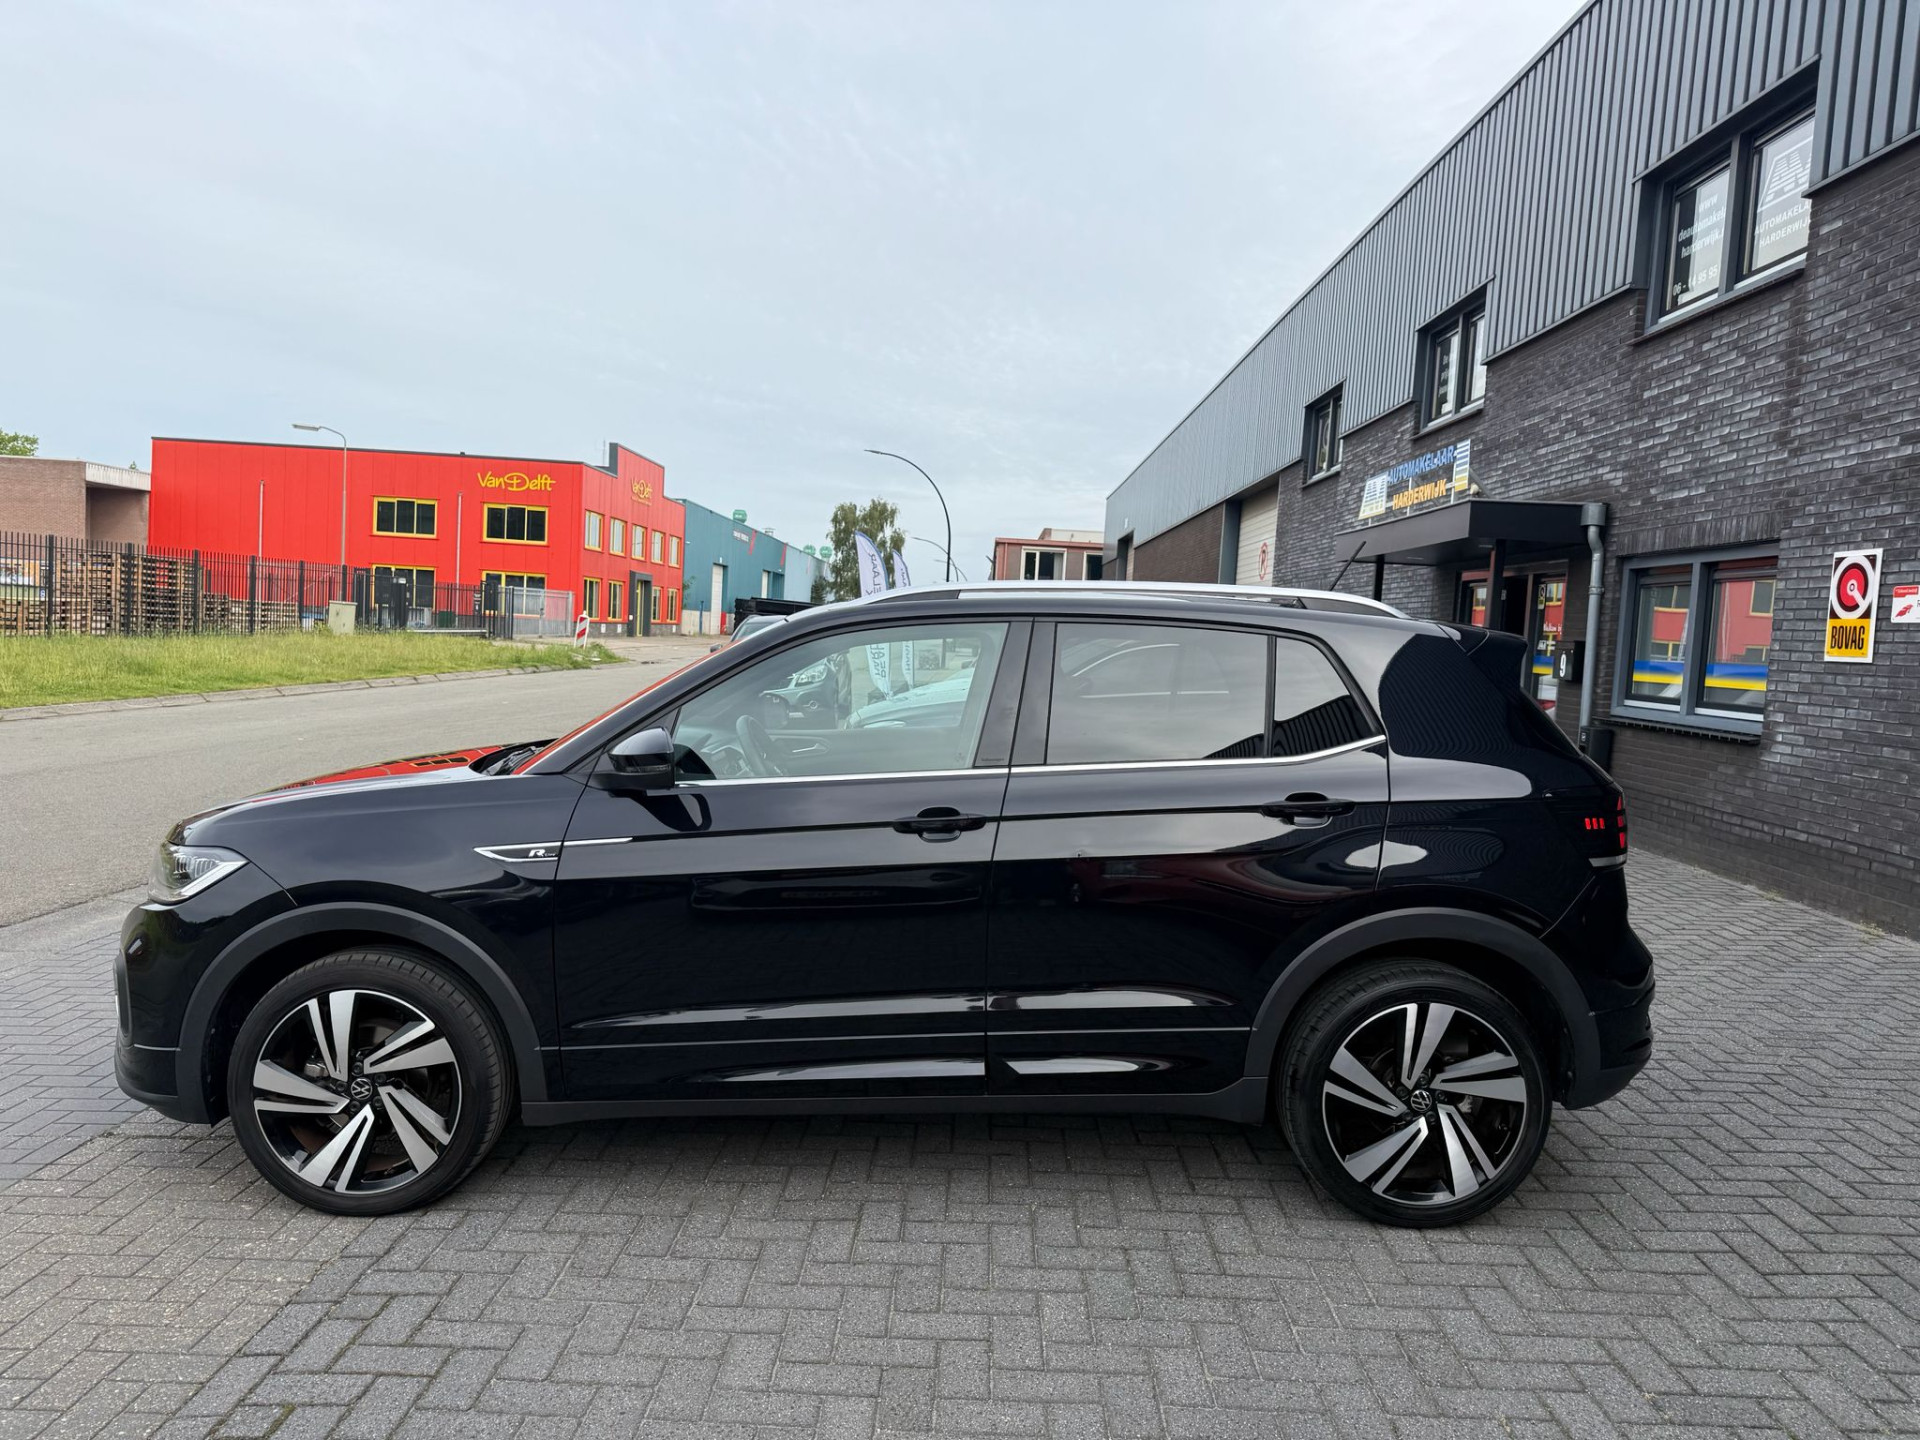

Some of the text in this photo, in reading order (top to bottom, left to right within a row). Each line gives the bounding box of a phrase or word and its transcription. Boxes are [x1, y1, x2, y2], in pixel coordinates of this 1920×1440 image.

[1392, 478, 1447, 510] HARDERWIJK
[1830, 625, 1865, 650] BOVAG
[1559, 653, 1567, 678] 9
